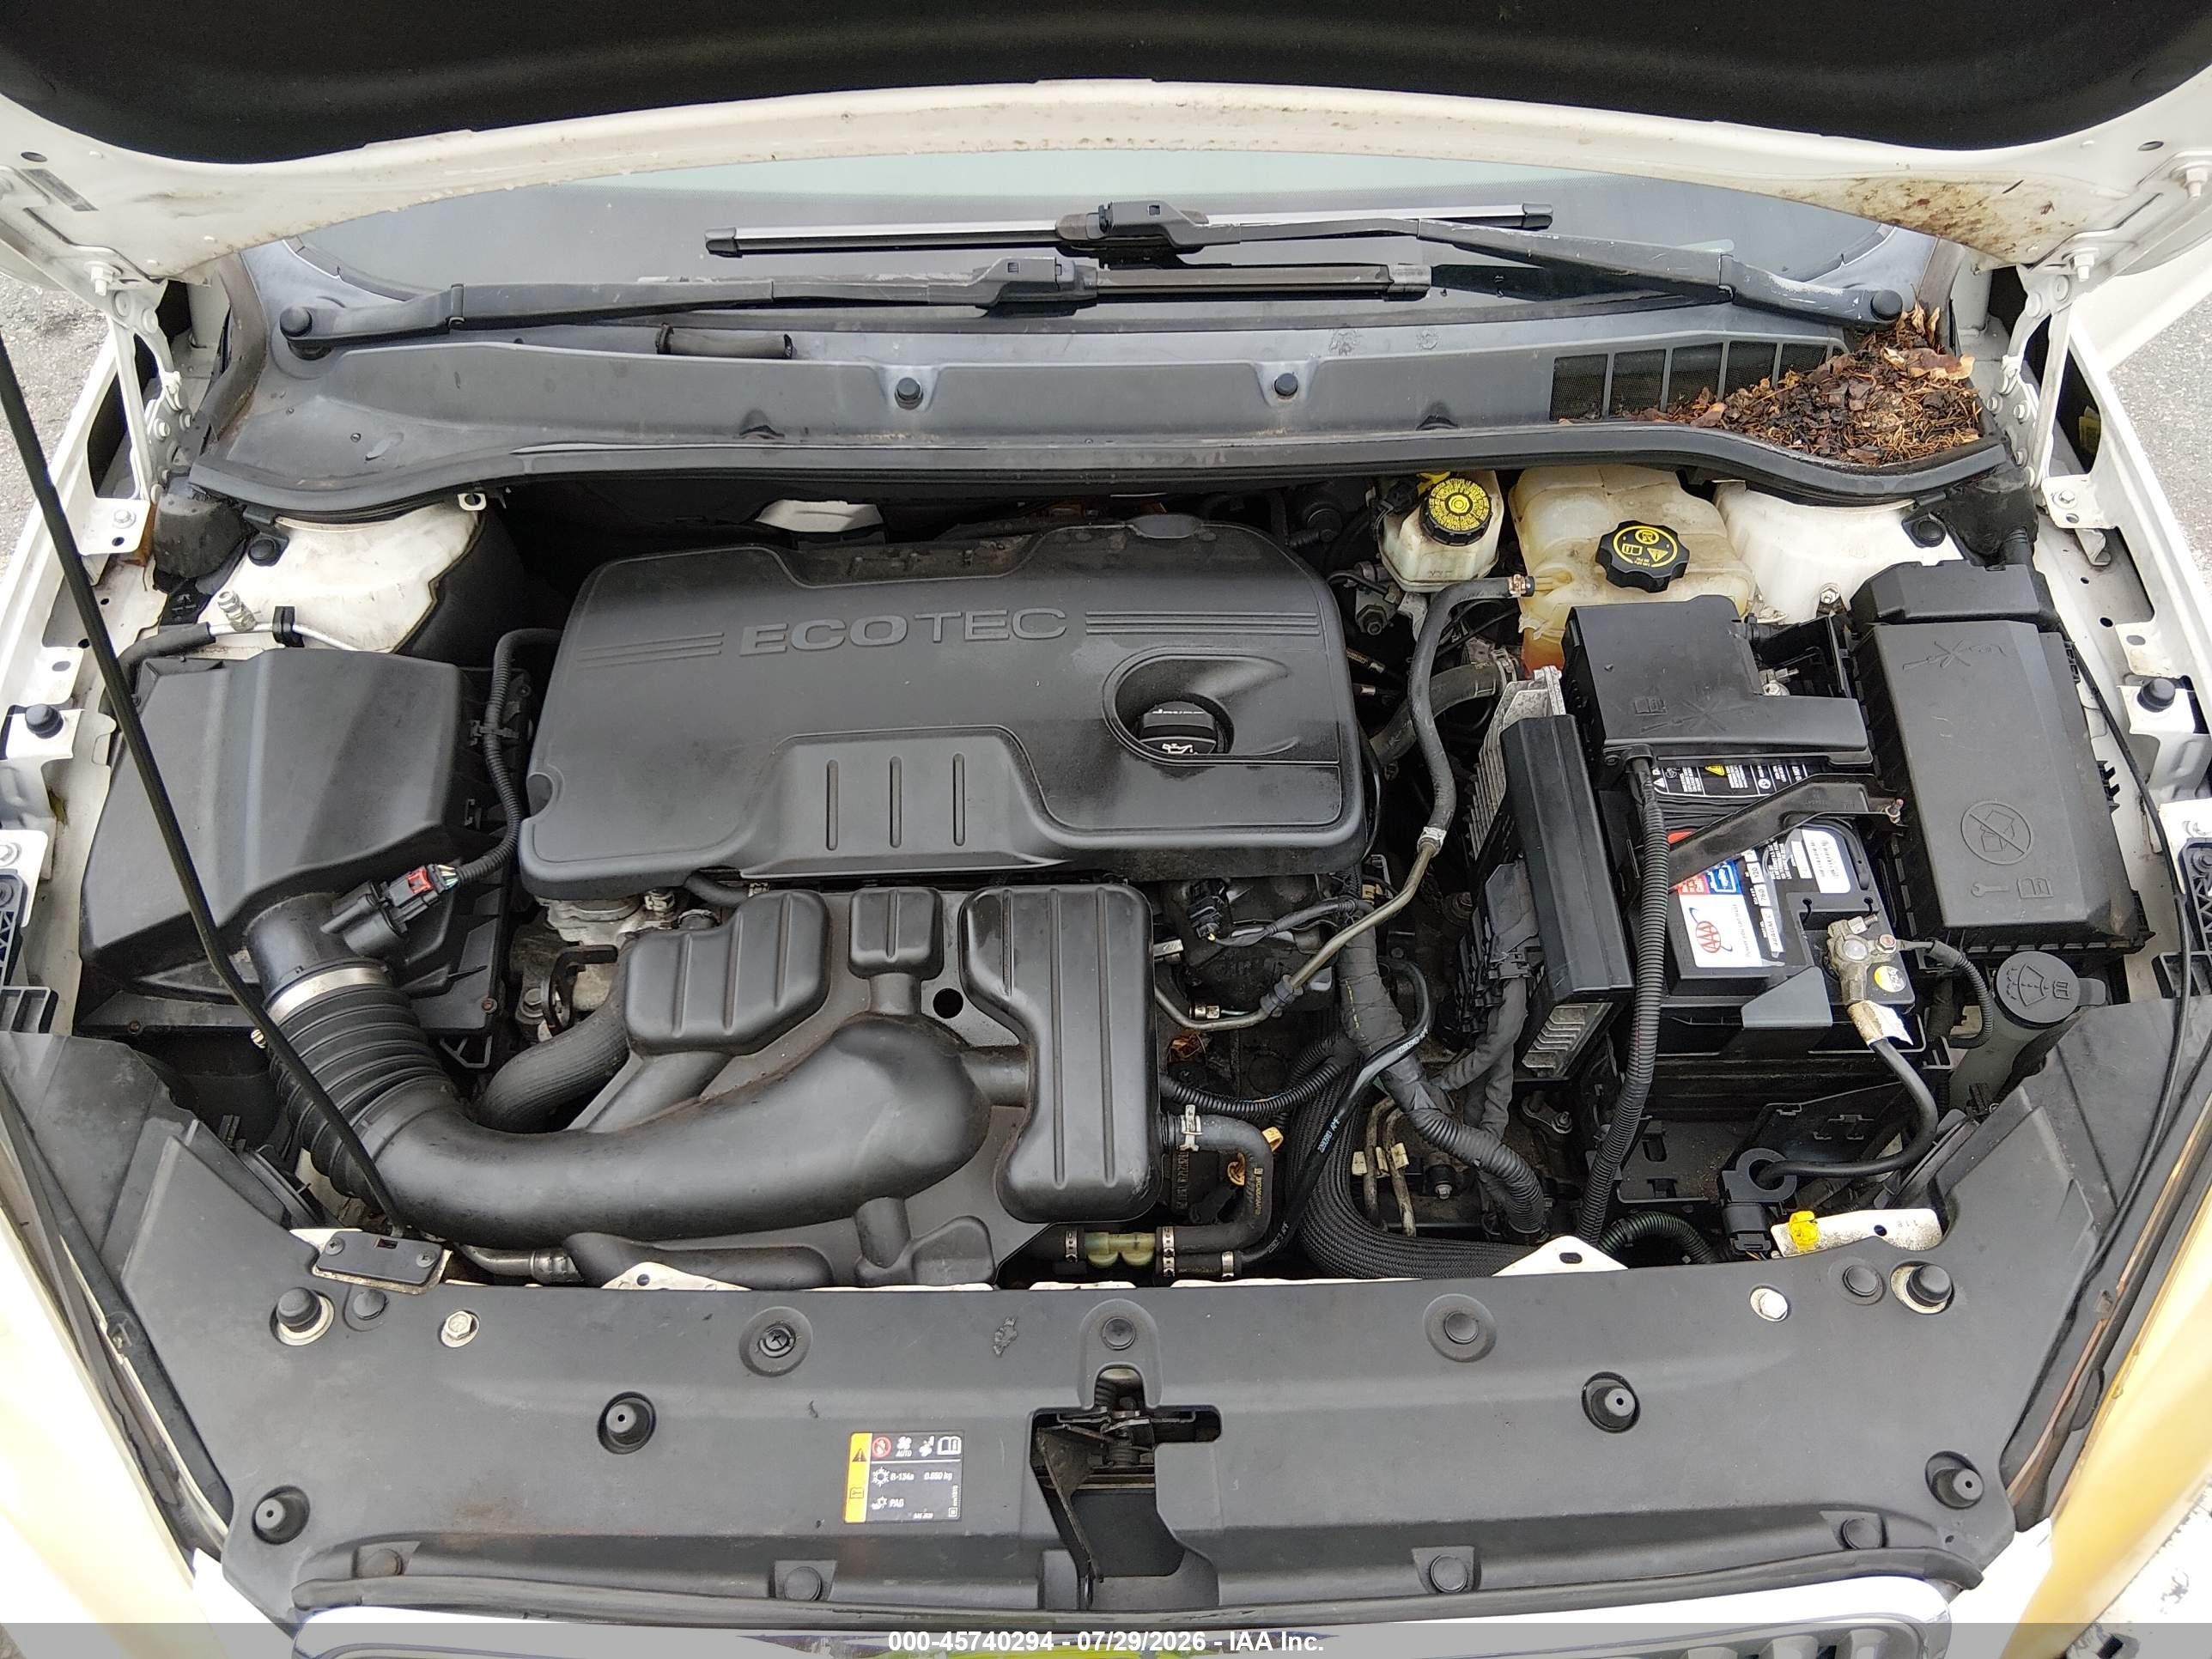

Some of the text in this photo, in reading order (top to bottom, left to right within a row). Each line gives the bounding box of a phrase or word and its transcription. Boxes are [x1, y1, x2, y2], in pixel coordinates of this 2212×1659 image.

[739, 607, 1067, 656] ECOTEC
[1696, 925, 1722, 951] AAA
[896, 1449, 913, 1457] AUTO
[943, 1472, 953, 1482] kg
